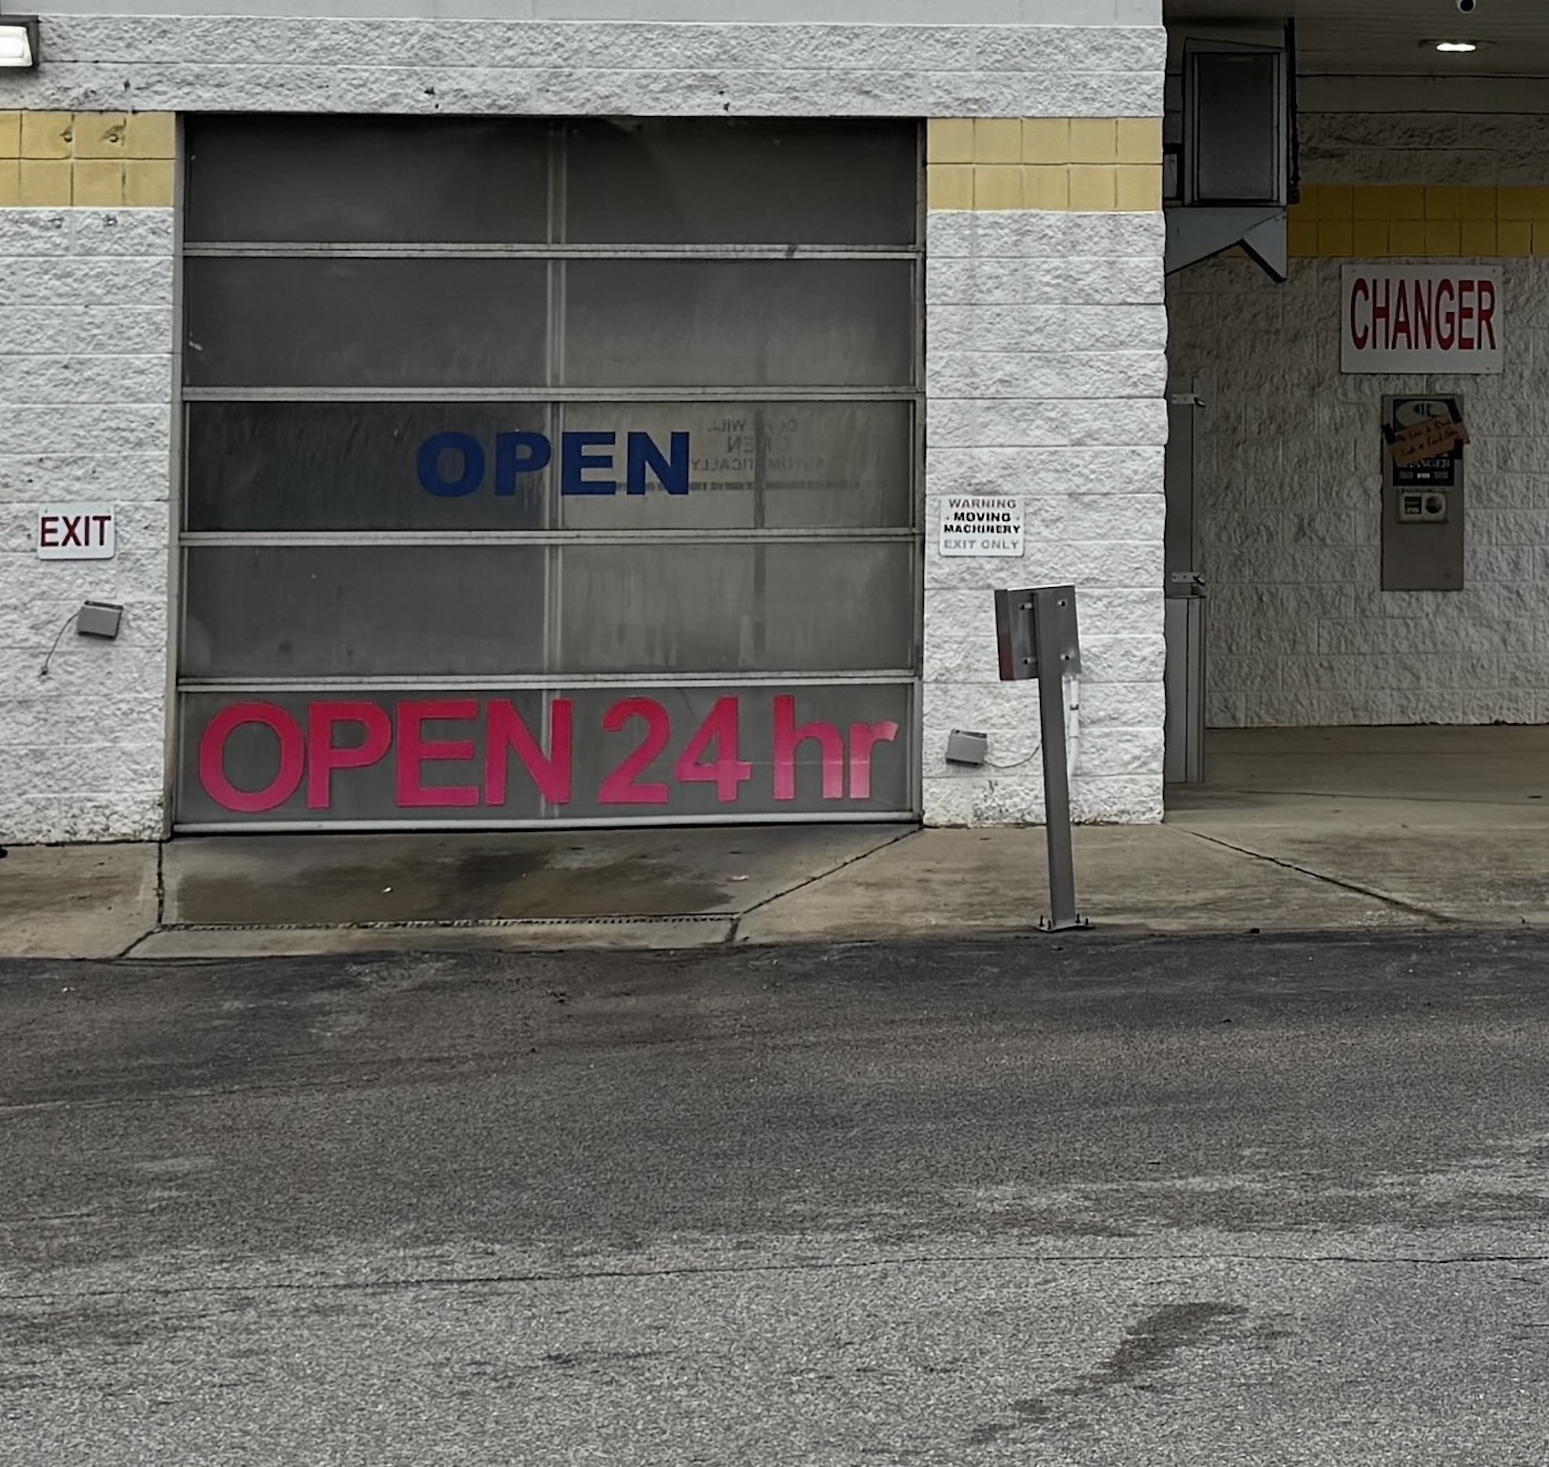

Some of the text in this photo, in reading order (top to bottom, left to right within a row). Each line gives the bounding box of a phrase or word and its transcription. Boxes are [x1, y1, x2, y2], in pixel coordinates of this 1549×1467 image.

[1350, 278, 1498, 351] CHANGER
[417, 431, 690, 497] OPEN
[949, 499, 1017, 509] WARNING
[954, 512, 1011, 522] MOVING
[39, 515, 112, 548] EXIT
[944, 524, 1021, 534] MACHINERY
[944, 540, 1019, 549] EXIT ONLY
[199, 694, 899, 813] OPEN 24 hr
